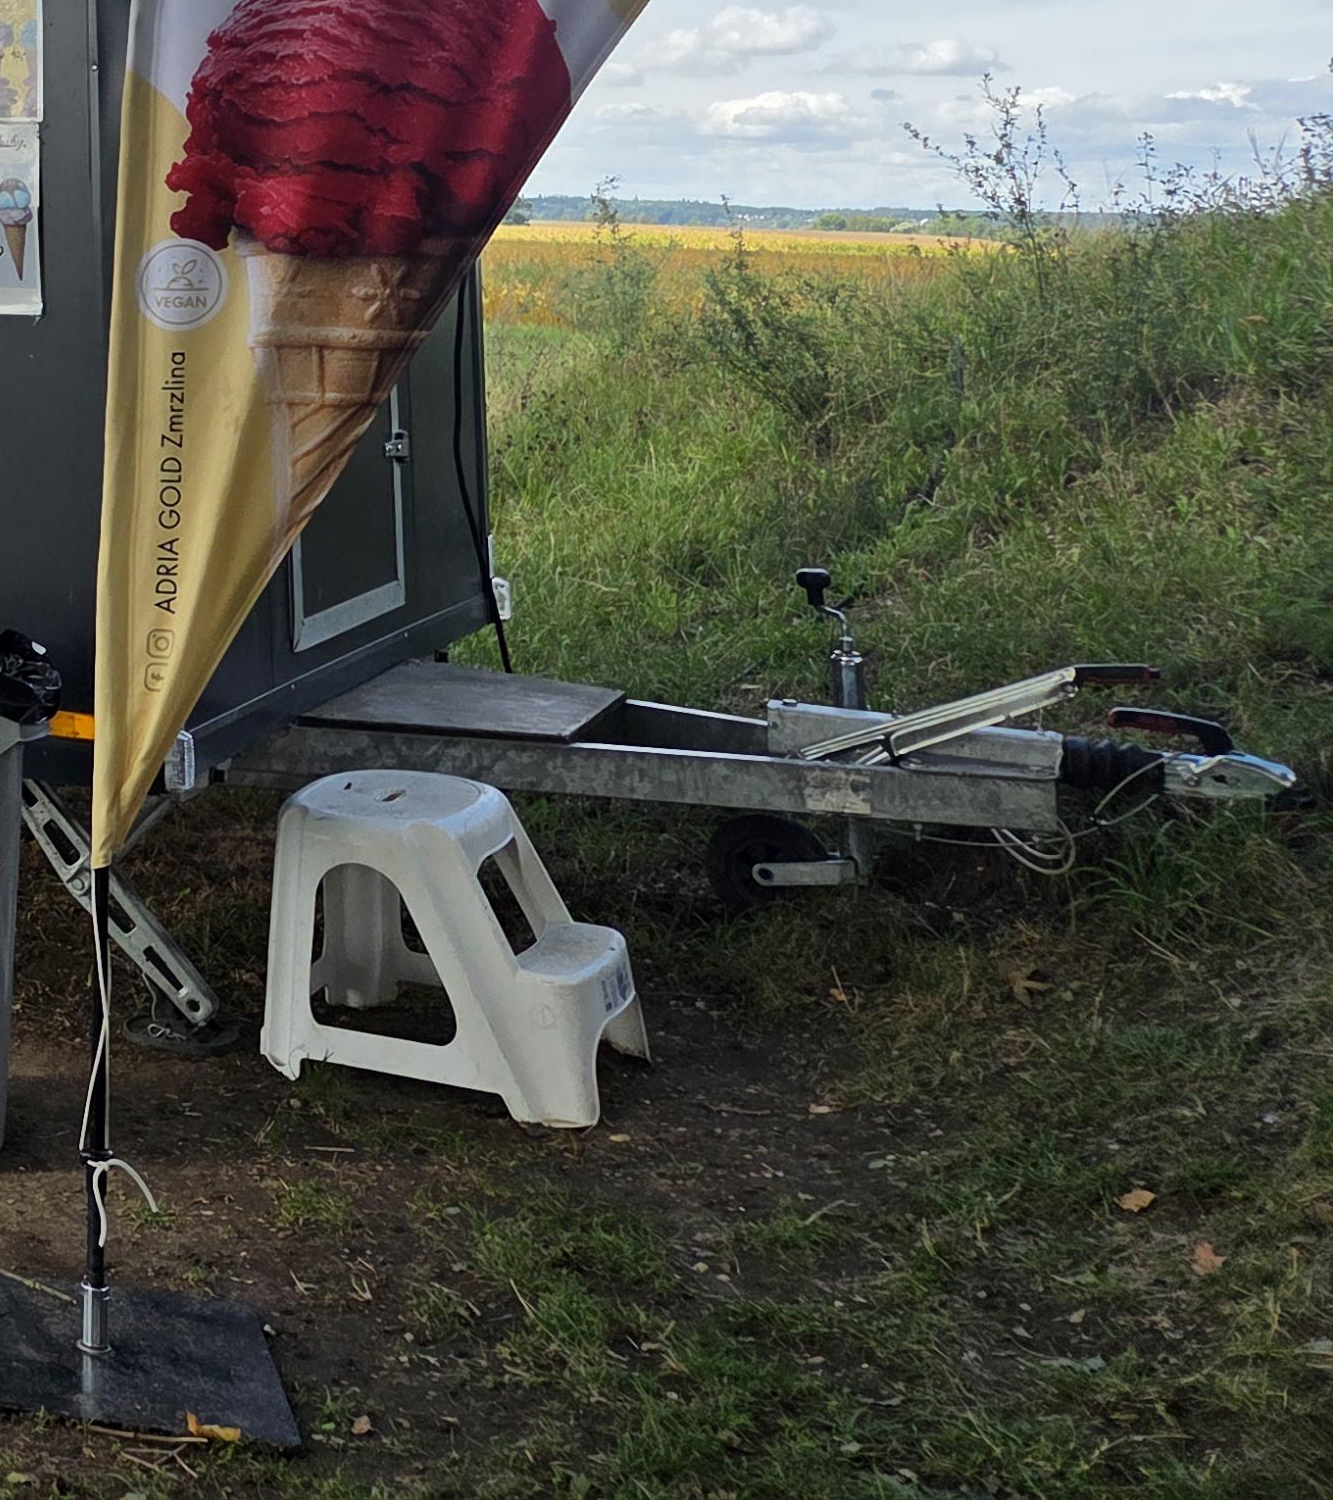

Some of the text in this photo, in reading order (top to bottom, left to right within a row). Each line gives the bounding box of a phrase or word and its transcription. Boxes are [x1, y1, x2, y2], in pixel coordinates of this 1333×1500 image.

[155, 295, 208, 309] VEGAN
[153, 350, 188, 615] ADRIA GOLD Zmrzlina
